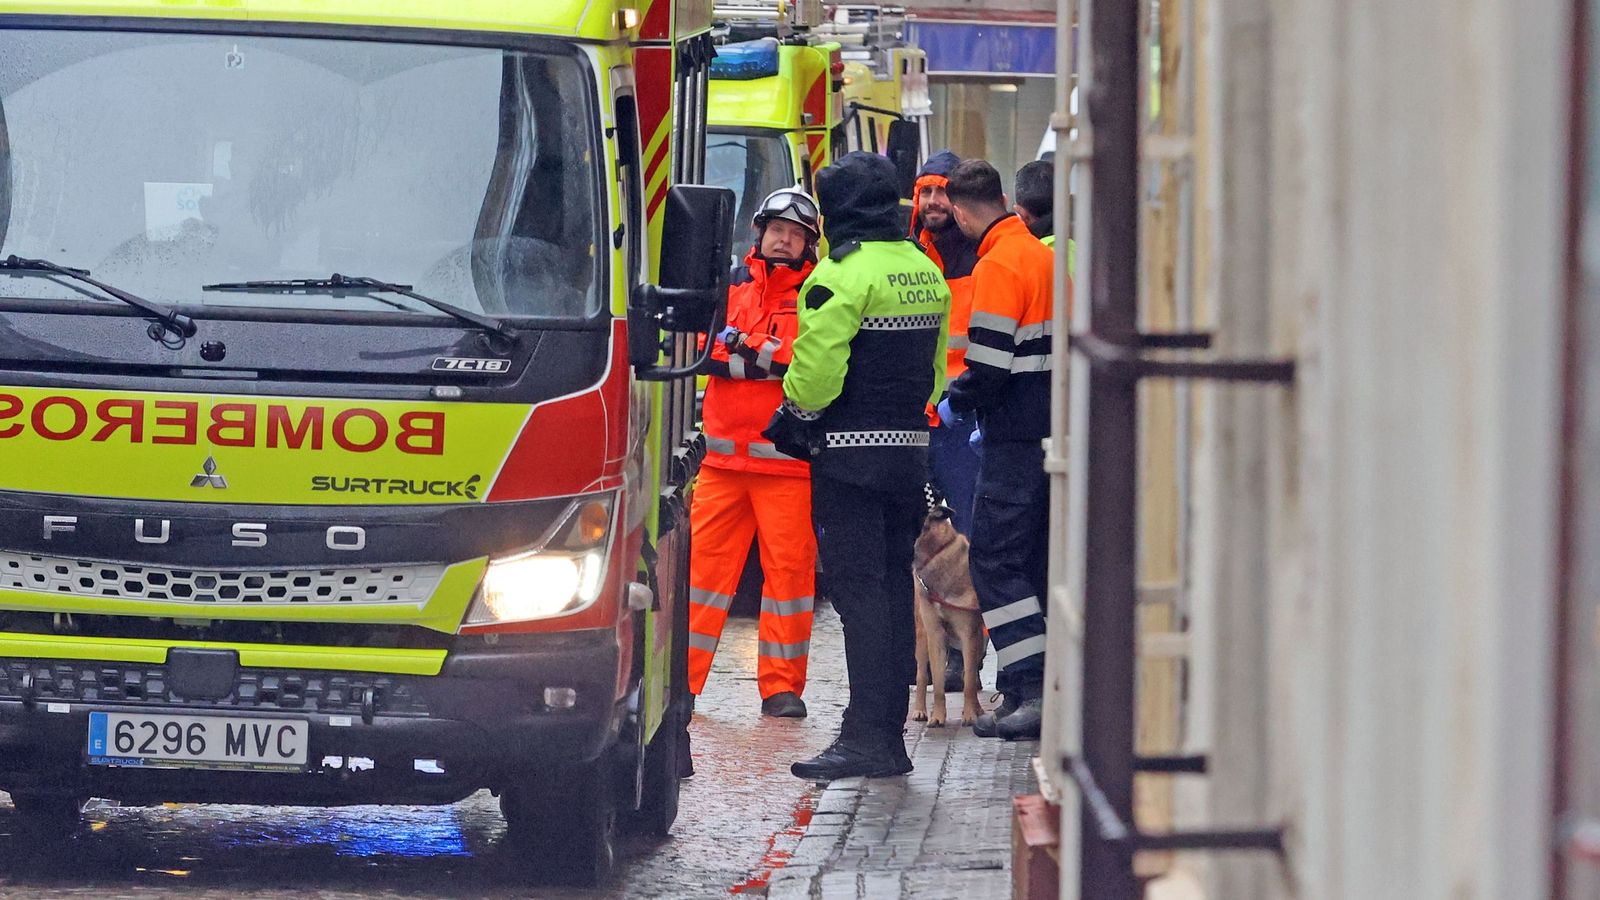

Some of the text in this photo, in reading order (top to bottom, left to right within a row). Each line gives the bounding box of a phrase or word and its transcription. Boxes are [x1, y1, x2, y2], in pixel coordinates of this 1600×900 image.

[887, 271, 940, 287] POLICIA
[898, 289, 941, 304] LOCAL
[444, 359, 502, 370] 7C18
[311, 476, 464, 497] SURTRUCK
[43, 515, 367, 551] FUSO
[94, 739, 102, 749] E
[114, 720, 297, 758] 6296 MVC
